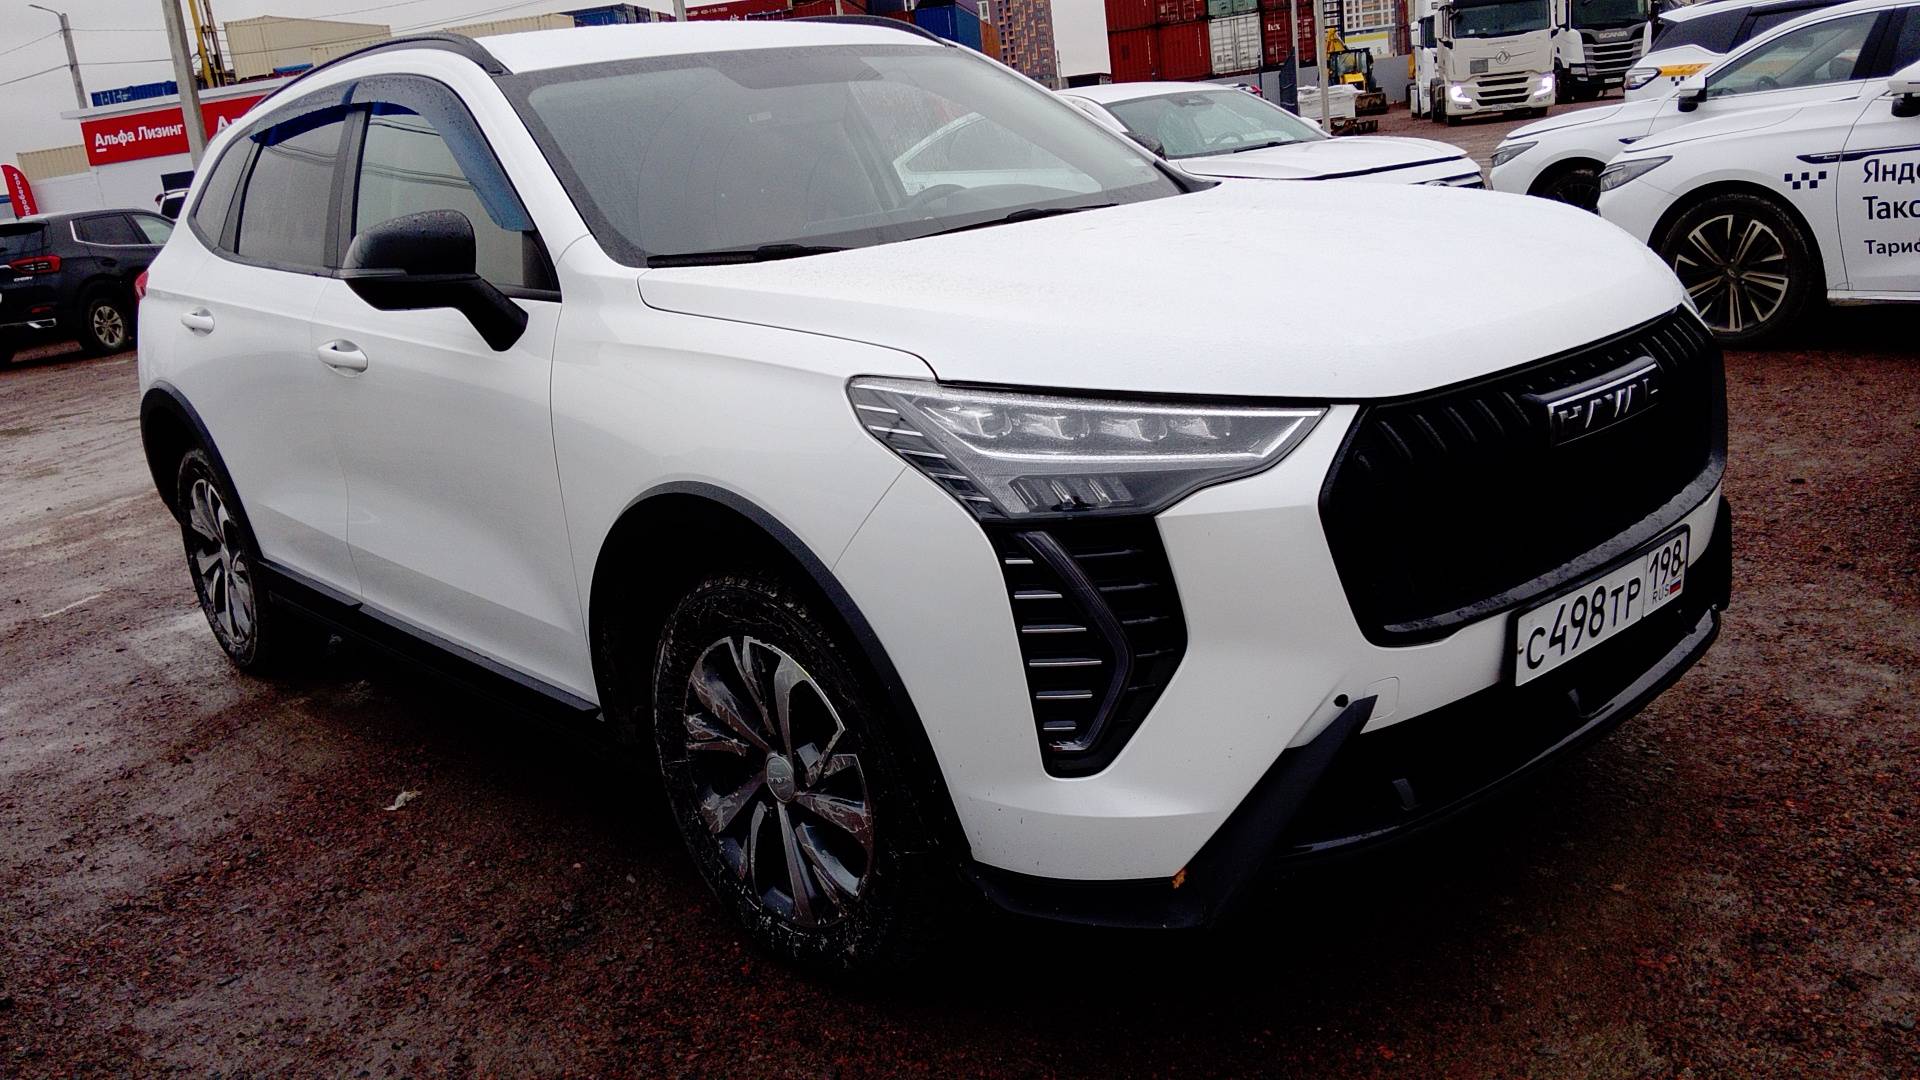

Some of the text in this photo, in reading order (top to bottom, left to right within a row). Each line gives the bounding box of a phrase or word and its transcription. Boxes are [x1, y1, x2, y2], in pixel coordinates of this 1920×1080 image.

[1599, 30, 1628, 39] SCANIA
[95, 124, 184, 147] Альфа Лизинг
[217, 114, 242, 135] А
[1863, 158, 1920, 185] Янд
[1649, 539, 1682, 590] 198
[1652, 586, 1670, 604] RUS
